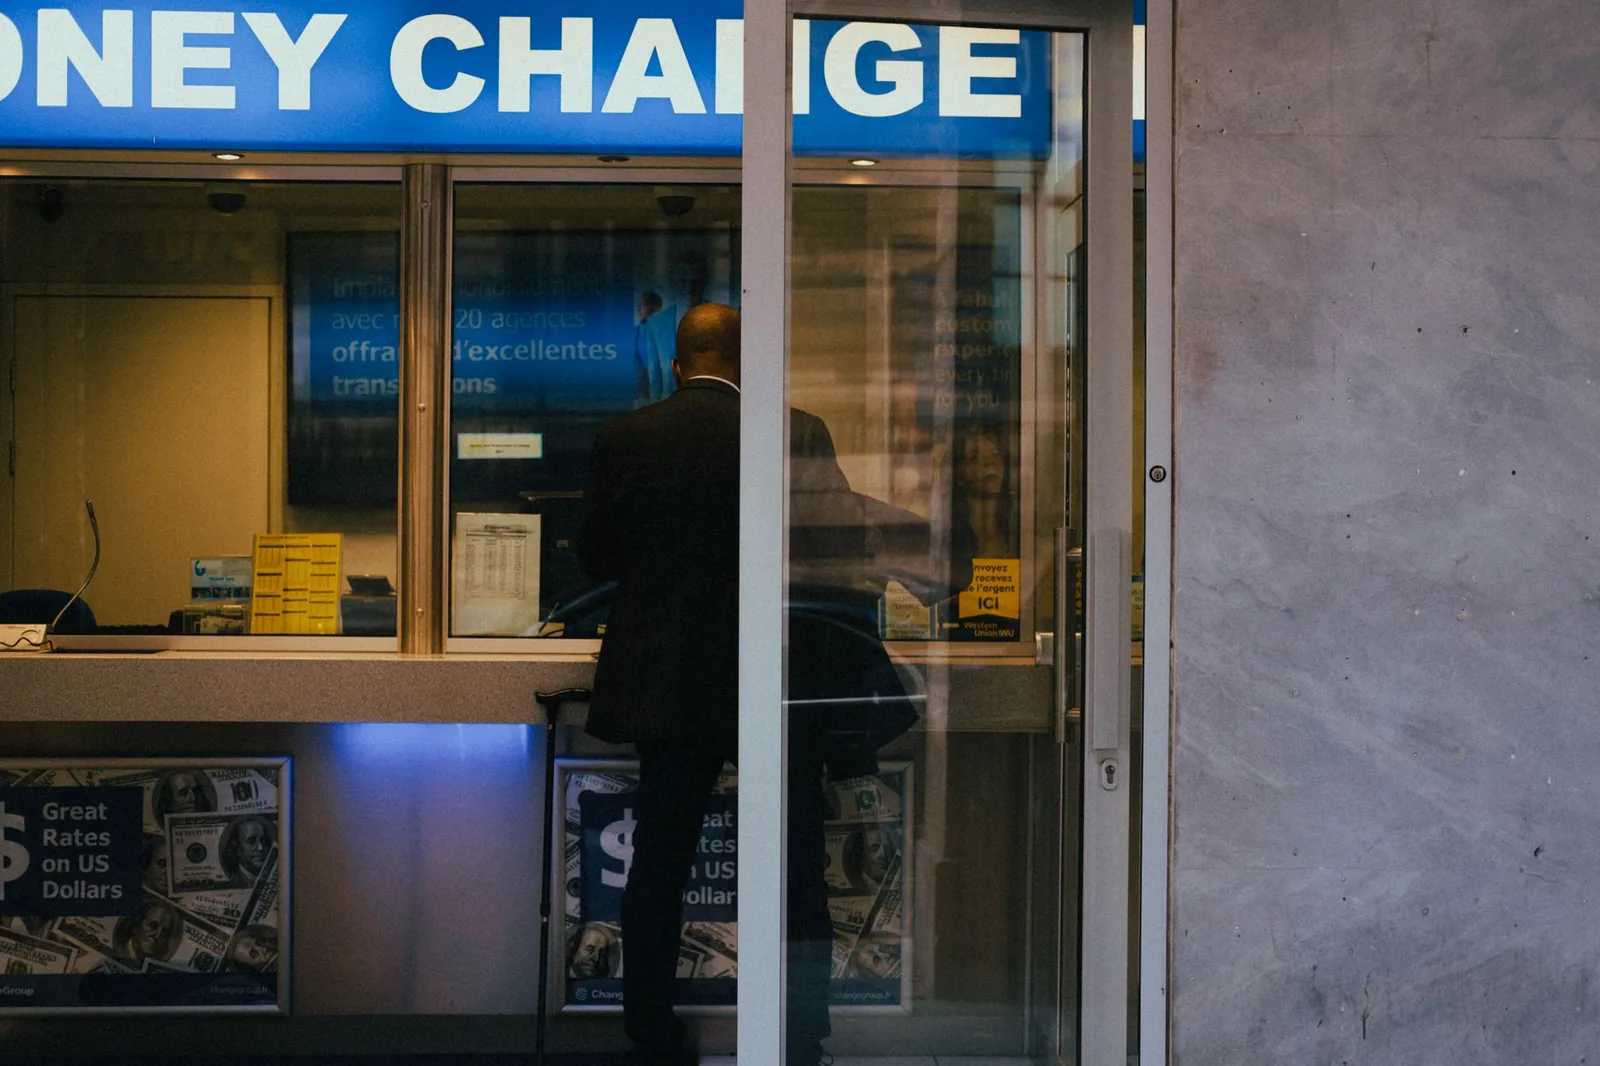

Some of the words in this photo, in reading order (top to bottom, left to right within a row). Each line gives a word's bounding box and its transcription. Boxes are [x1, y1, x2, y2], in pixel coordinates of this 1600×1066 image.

[0, 9, 349, 111] NEY
[332, 313, 384, 330] avec
[491, 312, 586, 334] agences
[332, 340, 396, 362] offra
[974, 564, 1008, 574] nvoyez
[976, 583, 1016, 595] l'argent
[978, 596, 999, 610] ICI
[42, 802, 108, 820] Great
[702, 810, 734, 828] eat
[42, 828, 111, 847] Rates
[696, 835, 737, 853] tes
[42, 858, 73, 873] on
[78, 855, 110, 873] US
[704, 860, 736, 879] US
[42, 880, 123, 899] Dollars
[682, 886, 737, 905] ollar
[0, 986, 34, 997] Group
[591, 988, 624, 1001] Chang
